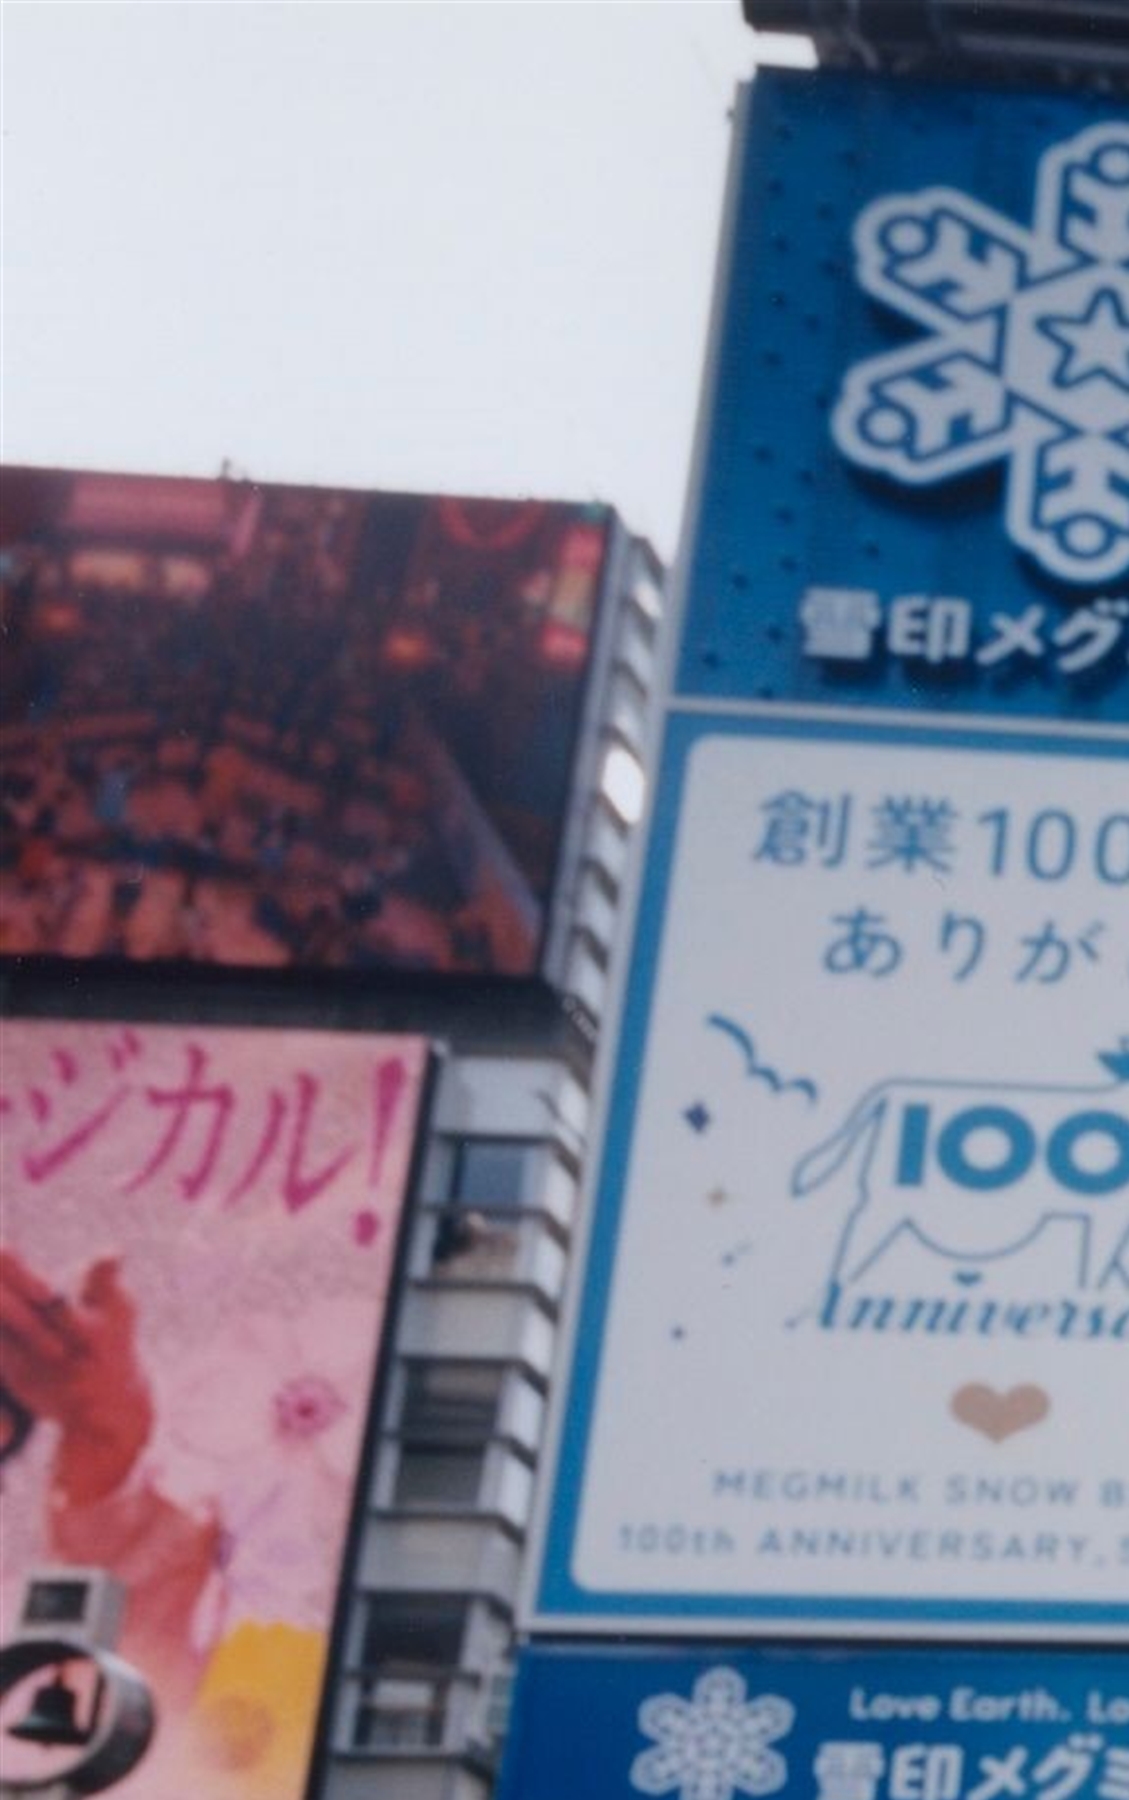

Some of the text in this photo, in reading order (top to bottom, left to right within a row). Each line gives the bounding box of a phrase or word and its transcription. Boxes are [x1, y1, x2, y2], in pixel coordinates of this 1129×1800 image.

[0, 1030, 407, 1248] ジカル!
[712, 1469, 920, 1504] MEGMILK
[945, 1473, 1078, 1507] SNOW
[618, 1524, 736, 1554] 100th
[849, 1687, 939, 1722] Love
[949, 1687, 1071, 1723] Earth.
